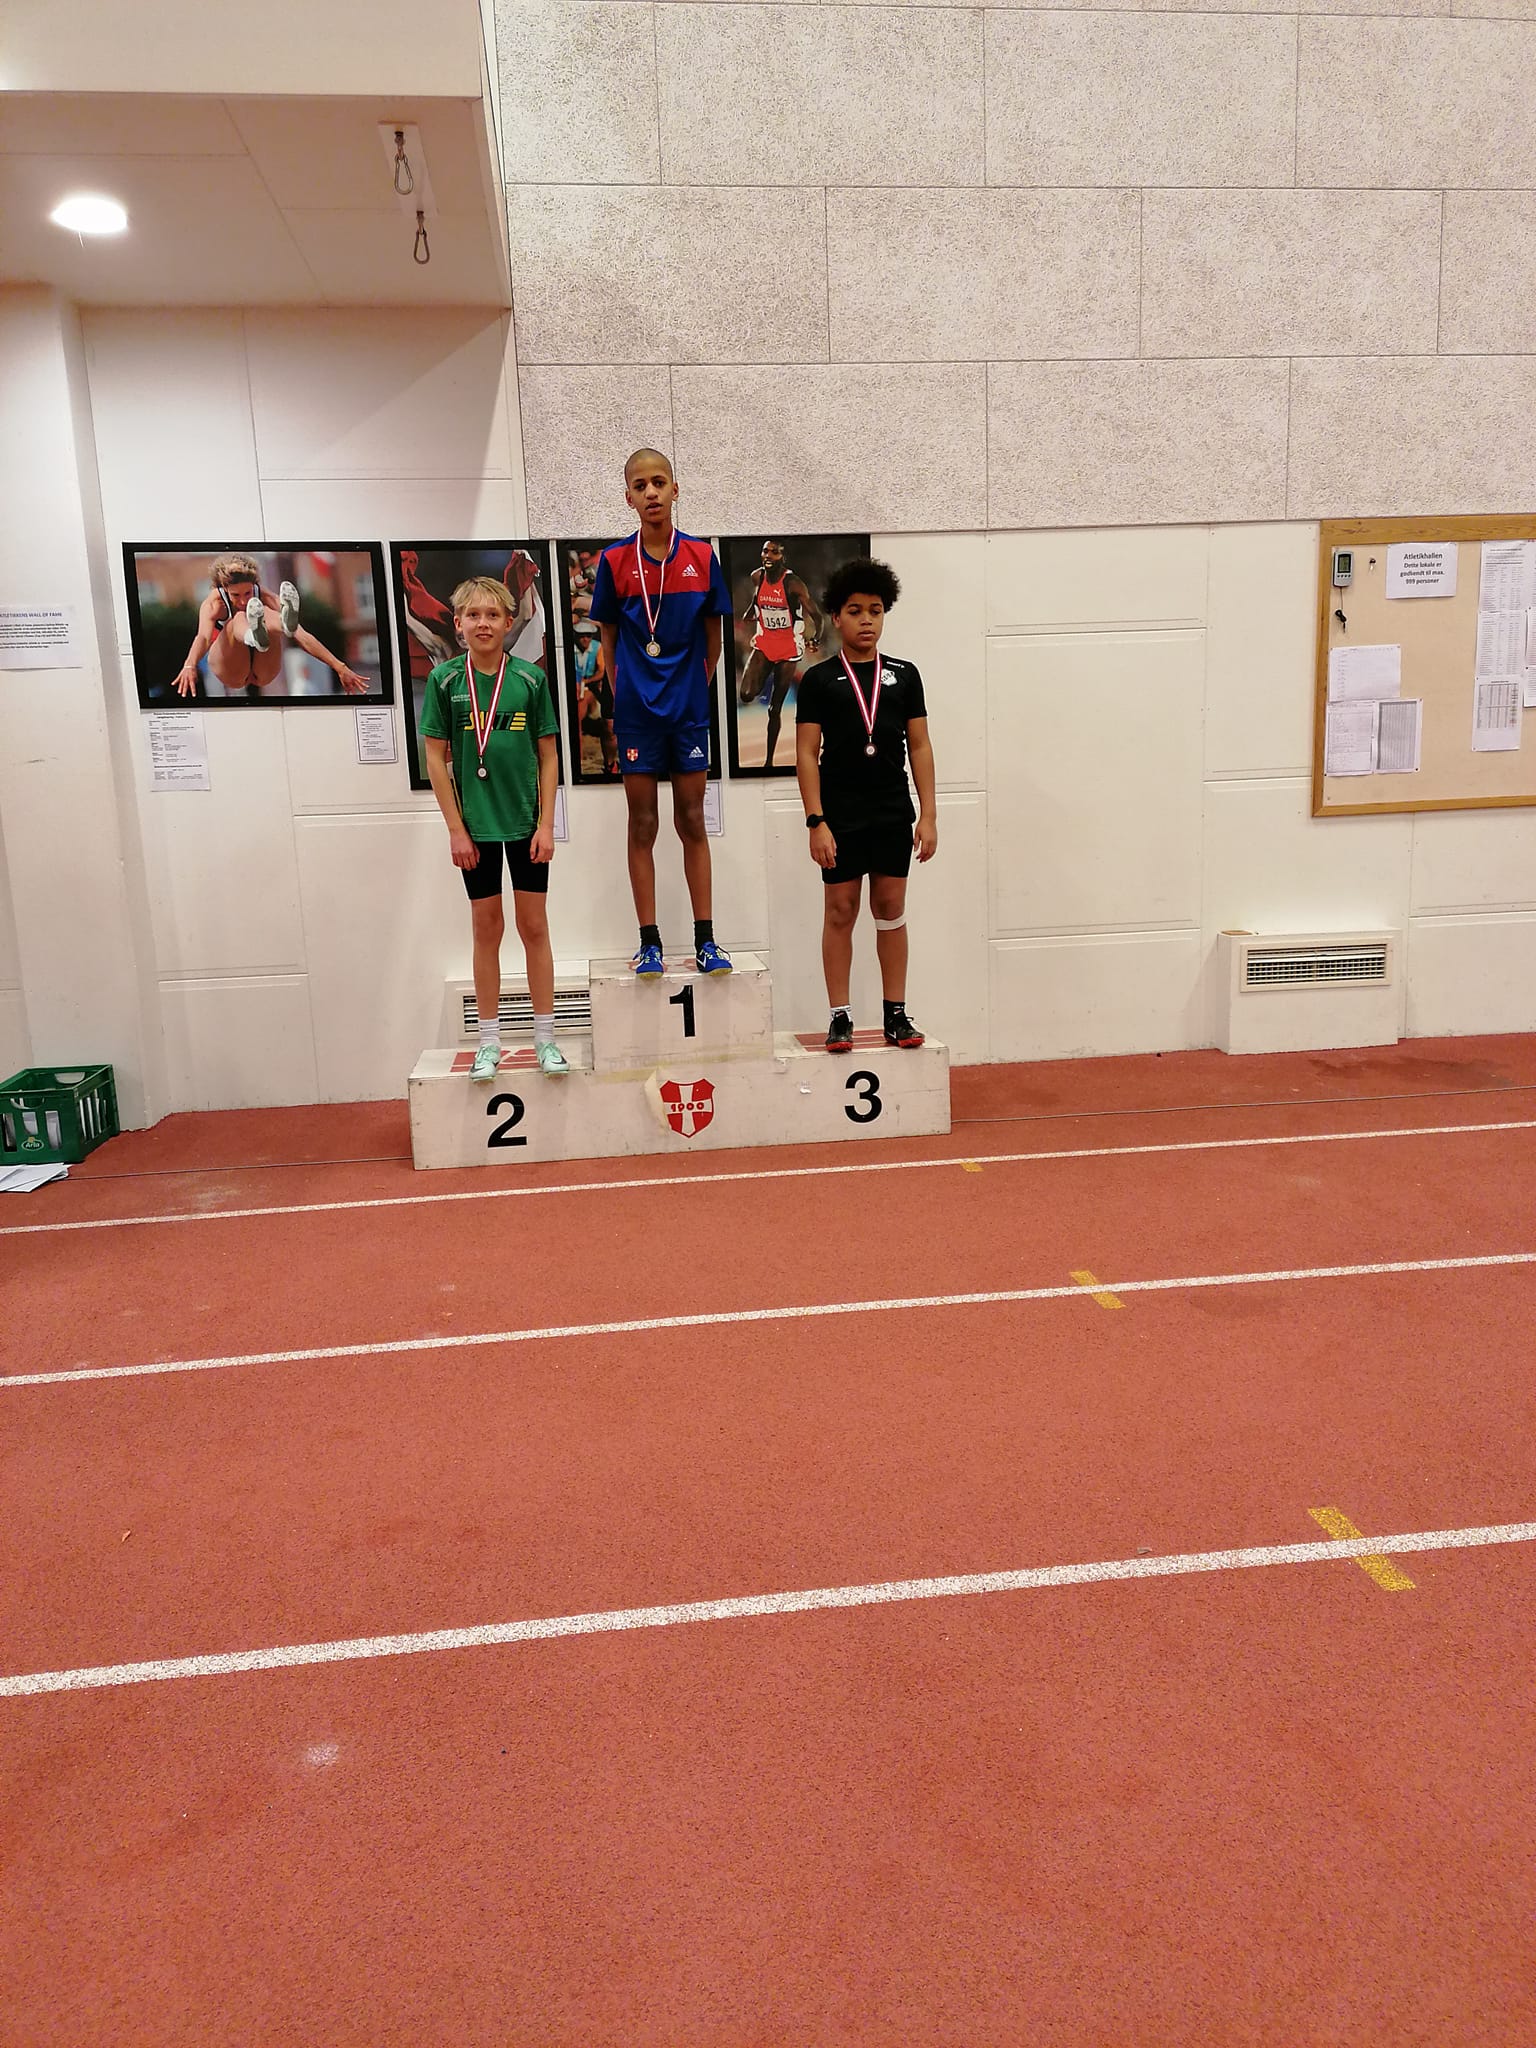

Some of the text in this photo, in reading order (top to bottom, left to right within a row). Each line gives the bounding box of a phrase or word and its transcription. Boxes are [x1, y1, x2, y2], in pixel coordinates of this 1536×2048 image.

[1403, 552, 1443, 560] Atletikhallen
[766, 616, 787, 627] 1542
[669, 984, 696, 1038] 1
[670, 1102, 705, 1113] 1900
[844, 1070, 883, 1124] 3
[486, 1093, 528, 1148] 2
